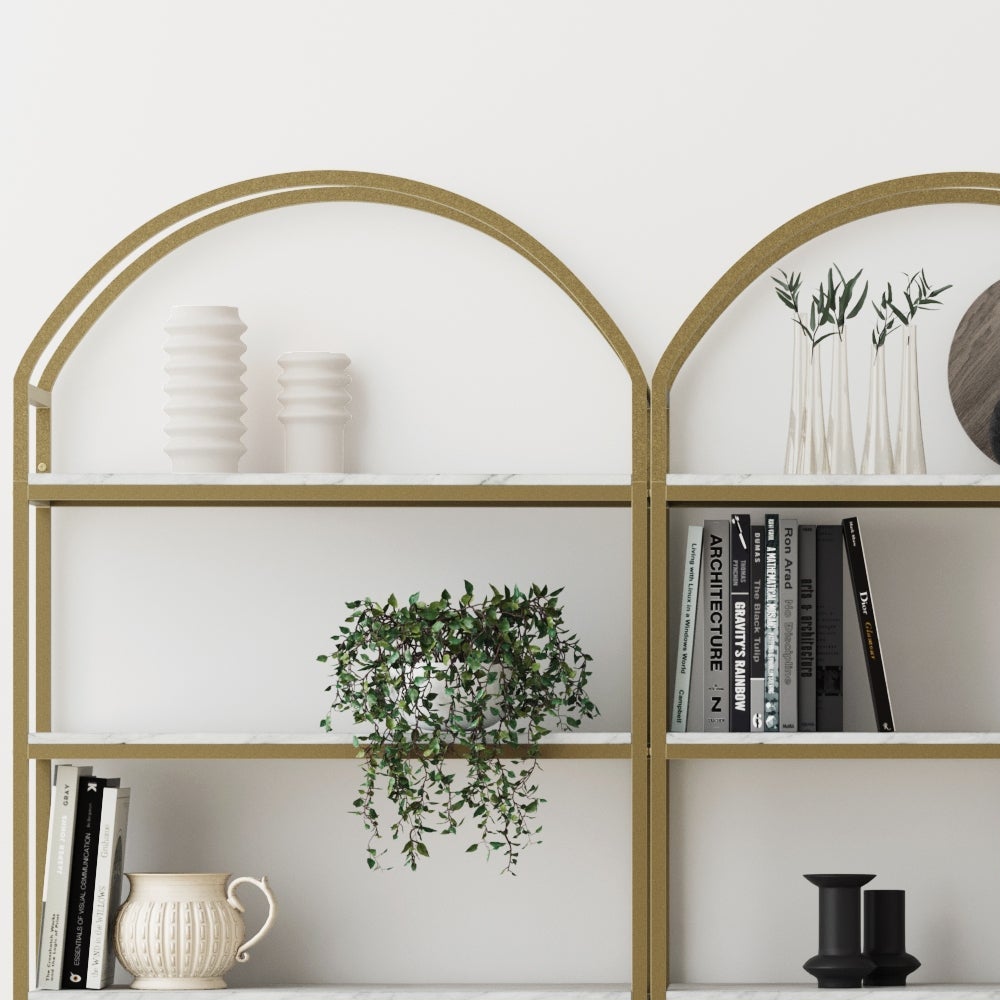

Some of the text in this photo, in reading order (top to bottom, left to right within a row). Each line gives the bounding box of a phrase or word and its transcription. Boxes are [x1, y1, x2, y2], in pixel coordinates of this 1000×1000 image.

[689, 543, 697, 565] Living
[784, 528, 793, 590] Ron Arad
[766, 552, 776, 602] MATHEMATICAL
[801, 579, 814, 598] arts
[710, 534, 722, 671] ARCHITECTURE
[766, 603, 776, 629] MOSAIC
[860, 591, 869, 615] Dior
[682, 620, 690, 651] Windows
[752, 637, 761, 662] Tulip
[800, 616, 815, 678] architecture
[680, 653, 688, 674] World
[734, 660, 746, 711] RAINBOW
[676, 690, 684, 723] Campbell
[81, 833, 91, 890] COMMUNICATION
[78, 916, 84, 925] OF
[74, 926, 83, 966] ESSENTIALS
